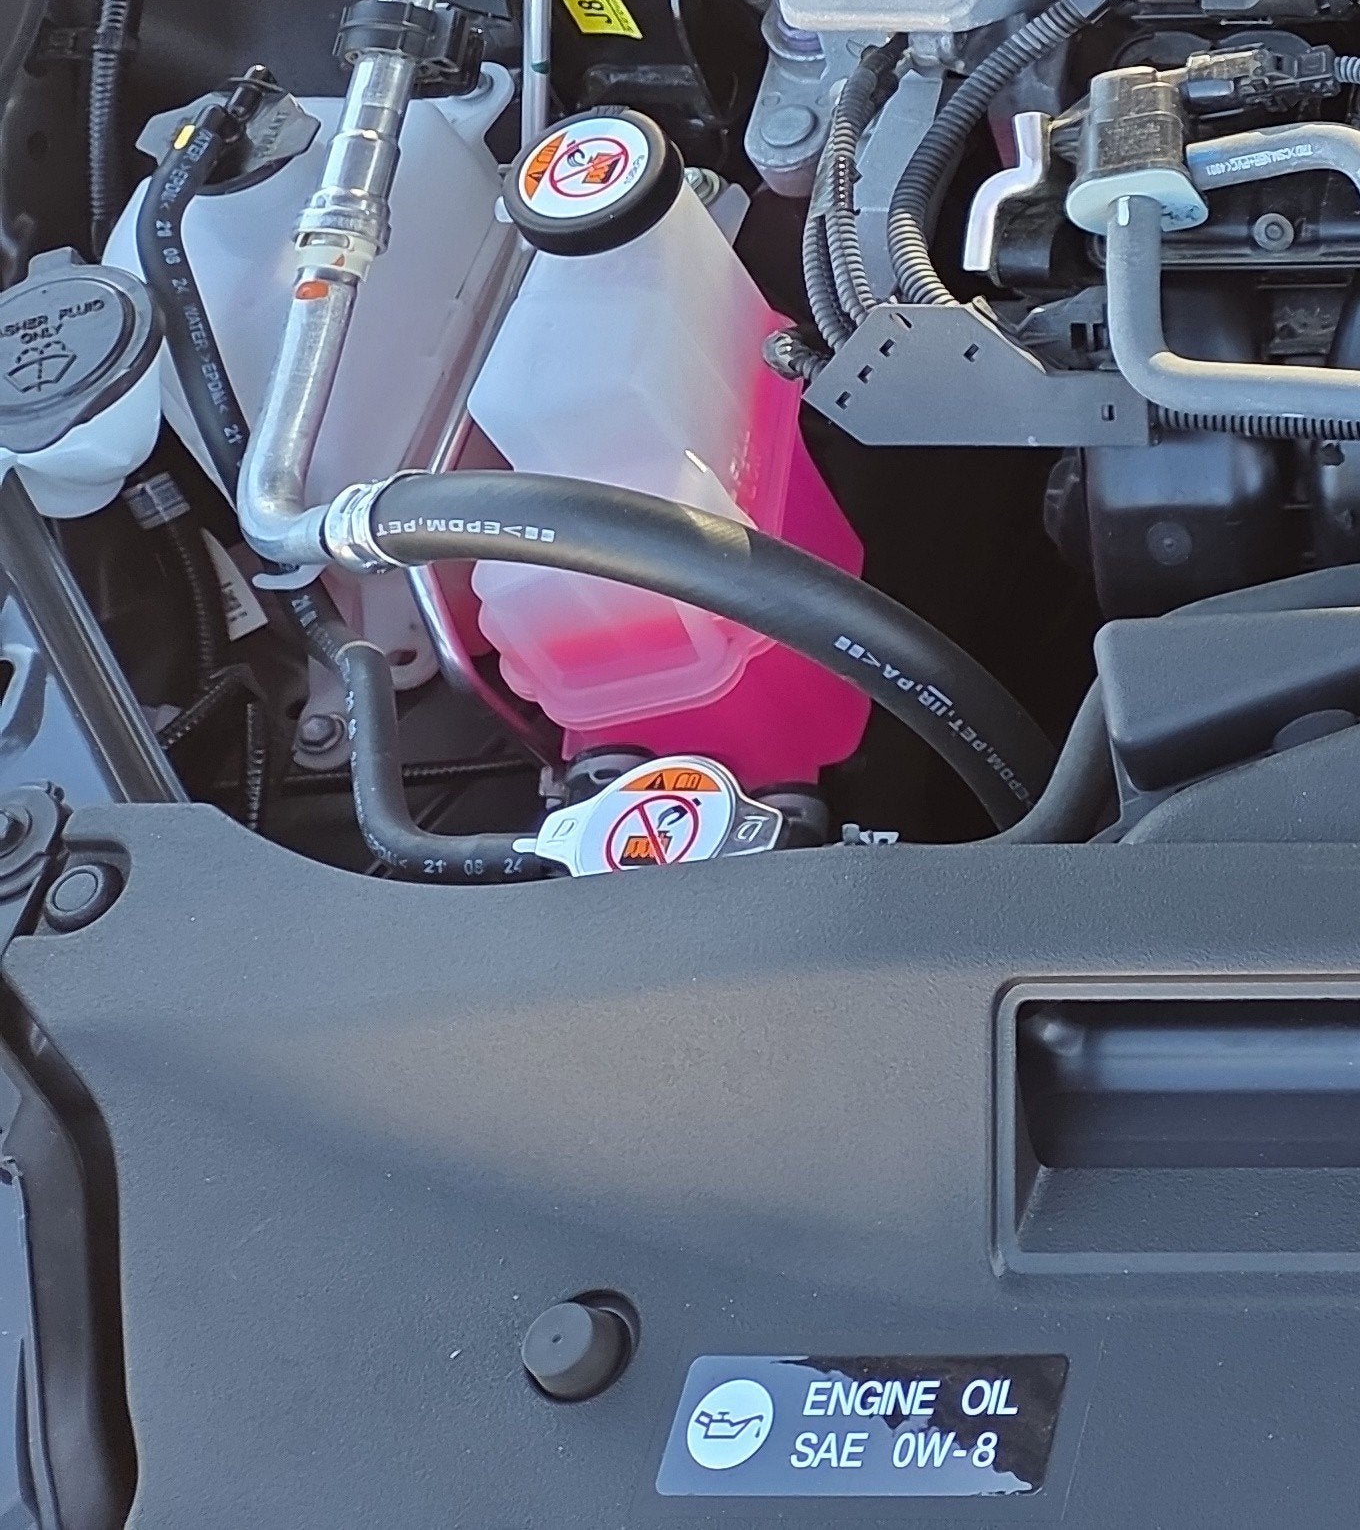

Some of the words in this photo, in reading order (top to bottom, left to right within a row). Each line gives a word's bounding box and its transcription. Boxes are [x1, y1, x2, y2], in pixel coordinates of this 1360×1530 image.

[577, 0, 613, 25] J8
[422, 859, 447, 874] 21
[802, 1379, 941, 1417] ENGINE
[960, 1378, 1020, 1417] OIL
[789, 1431, 870, 1469] SAE
[892, 1432, 998, 1469] 0W-8
